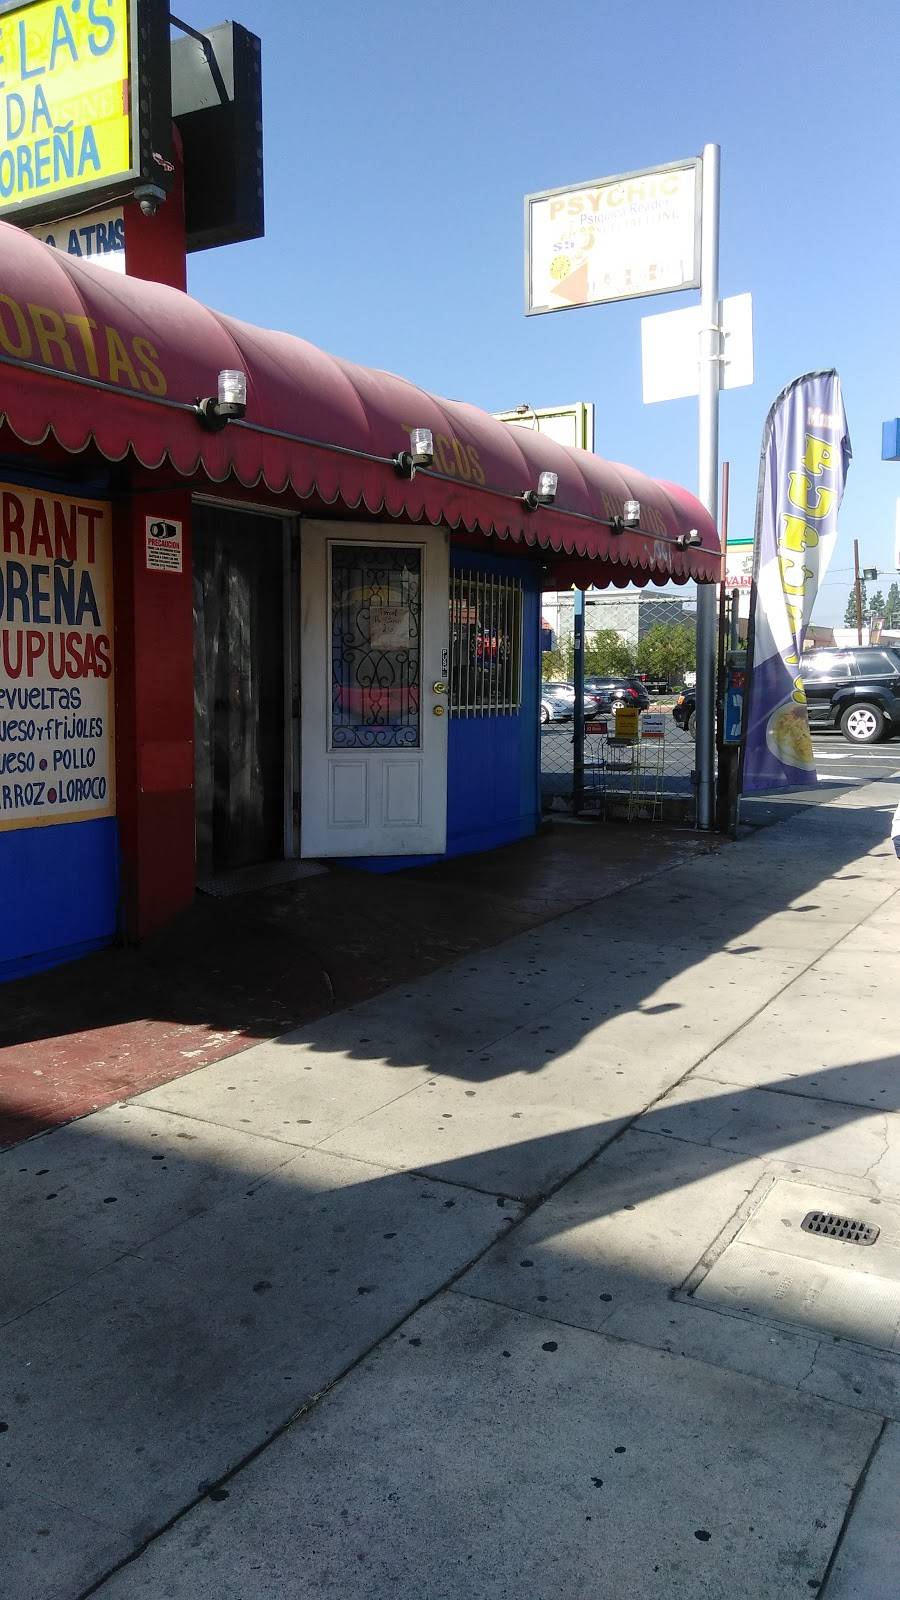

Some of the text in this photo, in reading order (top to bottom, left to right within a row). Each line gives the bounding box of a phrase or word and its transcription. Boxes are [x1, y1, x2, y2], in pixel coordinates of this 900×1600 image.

[0, 0, 116, 88] LA'S
[550, 174, 681, 221] PSYCHIC
[67, 218, 125, 258] ATRAS
[0, 292, 168, 397] ORTAS
[2, 491, 104, 564] RANT
[0, 558, 101, 627] REÑA
[53, 747, 96, 772] POLLO
[0, 776, 107, 810] RROZ LOROCO
